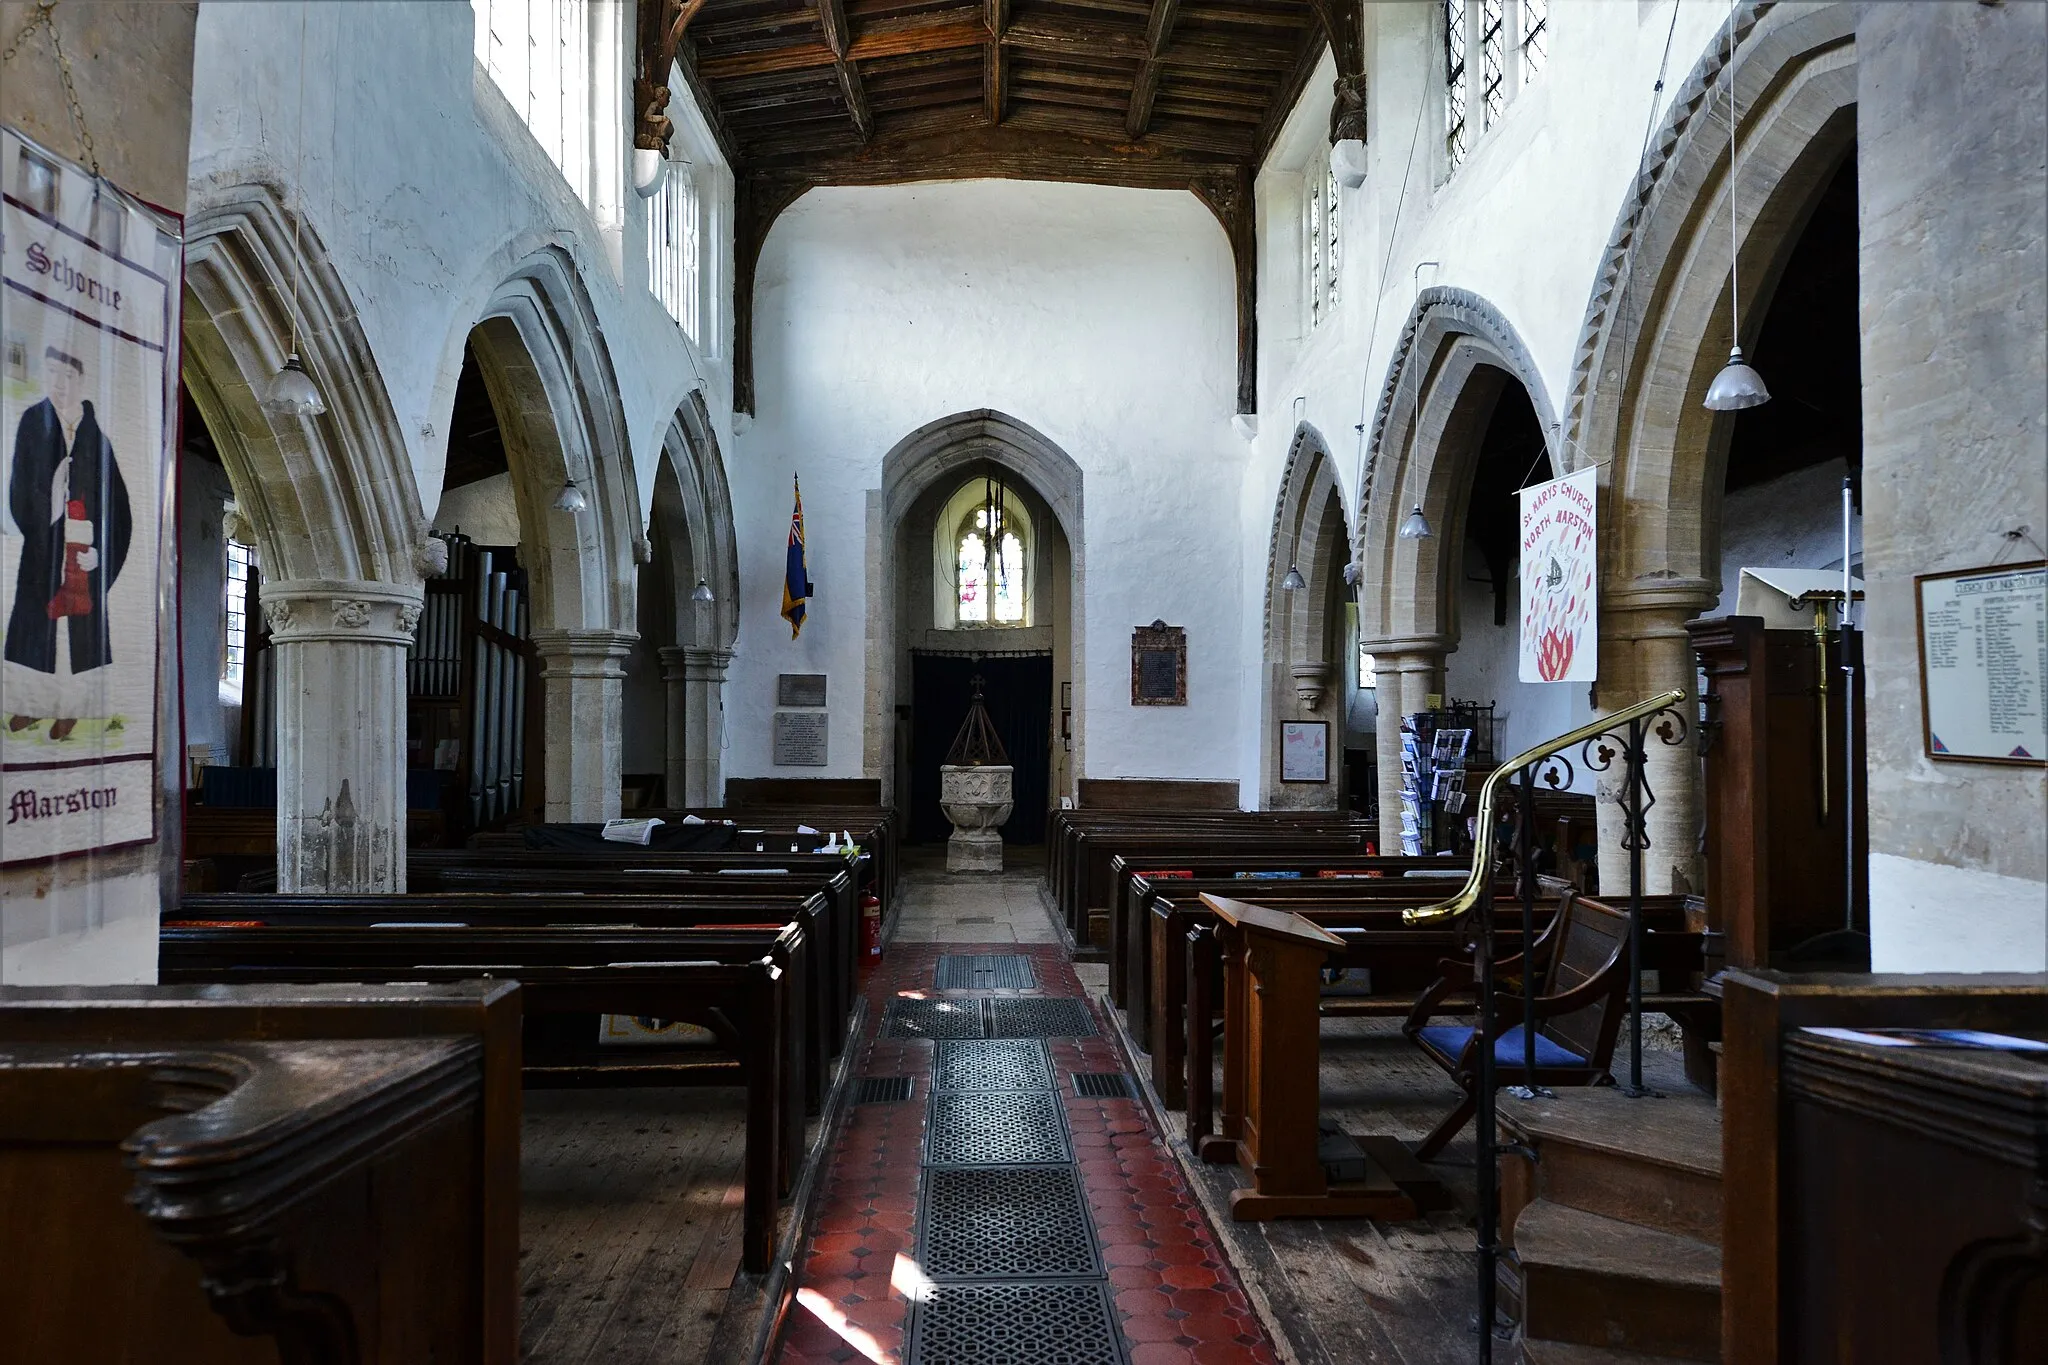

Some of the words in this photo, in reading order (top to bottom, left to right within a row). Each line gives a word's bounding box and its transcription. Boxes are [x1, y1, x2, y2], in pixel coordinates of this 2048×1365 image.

[26, 241, 121, 310] Schorne
[1532, 484, 1558, 514] MARYS
[1561, 482, 1593, 518] CHURCH
[1523, 513, 1551, 552] NORTH
[1555, 510, 1594, 541] MARSTON
[6, 785, 118, 825] Marston
